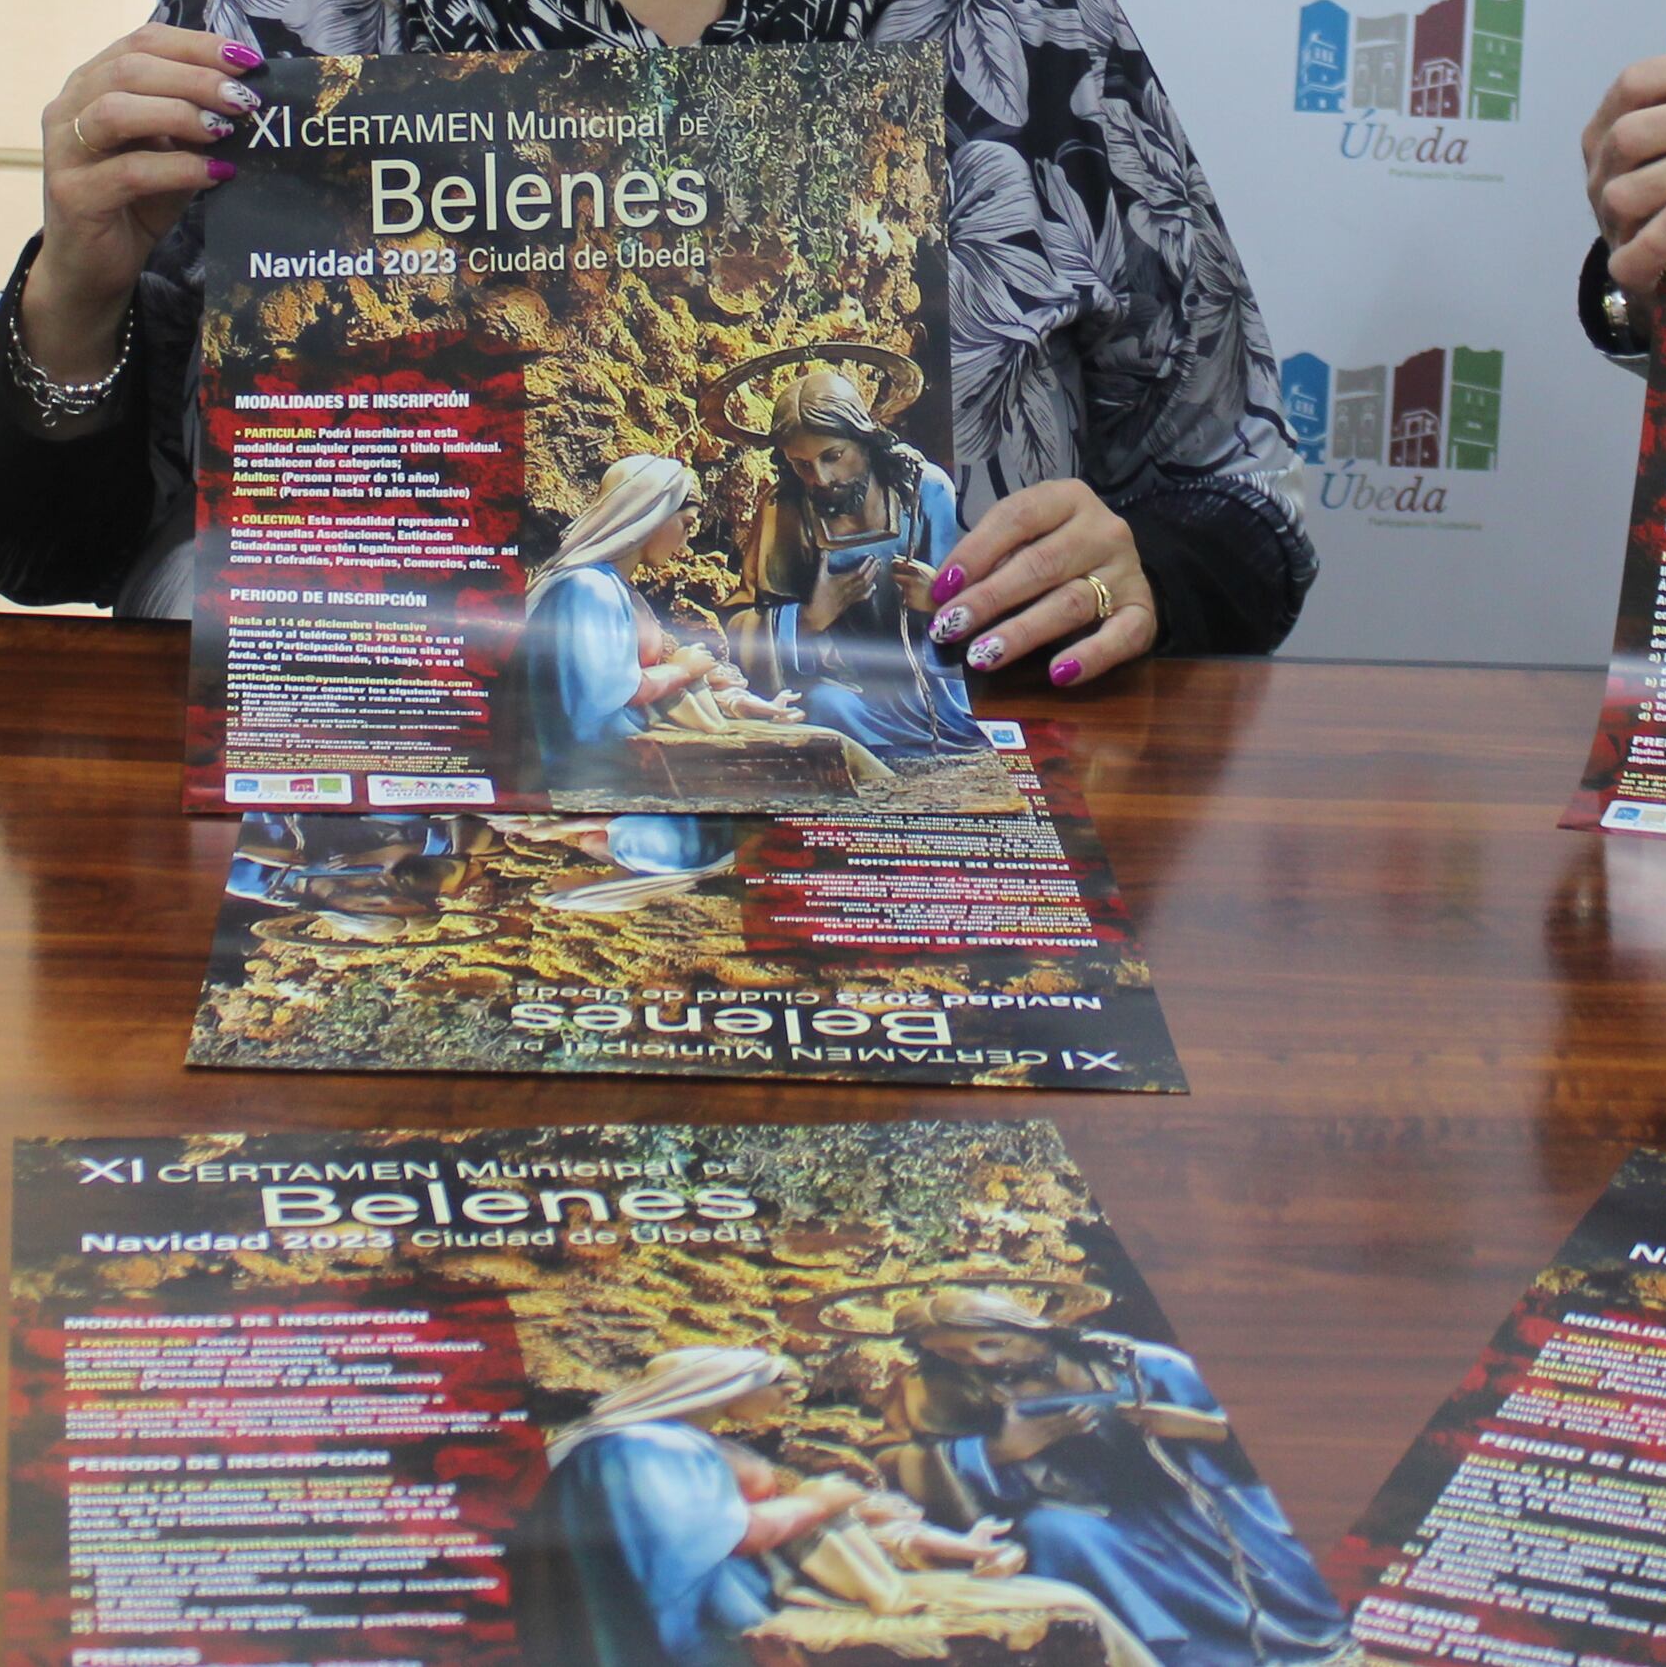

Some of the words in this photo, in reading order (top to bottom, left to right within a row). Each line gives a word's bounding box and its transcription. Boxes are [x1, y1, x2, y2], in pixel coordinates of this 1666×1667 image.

[248, 106, 290, 148] XI
[301, 112, 493, 146] CERTAMEN
[508, 107, 664, 144] Municipal
[679, 117, 708, 136] DE
[1341, 109, 1469, 164] Úbeda
[370, 152, 708, 235] Belenes
[250, 249, 374, 278] Navidad
[383, 246, 456, 274] 2023
[468, 245, 565, 272] Ciudad
[574, 244, 607, 270] de
[235, 395, 344, 409] MODALIDADES
[349, 394, 369, 408] DE
[373, 391, 470, 408] INSCRIPCIÓN
[245, 427, 315, 438] PARTICULAR:
[319, 427, 351, 438] Podrá
[354, 427, 413, 438] inscribirse
[417, 429, 431, 438] en
[434, 428, 458, 438] esta
[234, 443, 293, 453] modalidad
[296, 443, 349, 455] cualquier
[352, 445, 397, 455] persona
[401, 445, 407, 453] a
[411, 442, 440, 453] título
[443, 442, 501, 453] individual.
[234, 458, 247, 468] Se
[251, 458, 311, 468] establecen
[315, 458, 335, 468] dos
[233, 472, 279, 483] Adultos:
[282, 472, 331, 484] (Persona
[335, 474, 371, 485] mayor
[374, 472, 387, 483] de
[391, 473, 404, 483] 16
[408, 472, 440, 484] años)
[1321, 460, 1447, 513] Úbeda
[233, 486, 276, 497] Juvenil:
[280, 486, 330, 499] (Persona
[333, 487, 364, 497] hasta
[368, 487, 381, 497] 16
[385, 487, 412, 498] años
[415, 487, 470, 499] inclusive)
[230, 589, 298, 603] PERIODO
[303, 591, 323, 604] DE
[327, 591, 427, 607] INSCRIPCIÓN
[642, 988, 684, 1004] de
[696, 988, 820, 1006] Ciudad
[835, 991, 931, 1009] 2023
[942, 992, 1102, 1011] Navidad
[509, 1002, 952, 1046] Belenes
[565, 1041, 773, 1061] Municipal
[791, 1045, 1049, 1065] CERTAMEN
[1062, 1050, 1123, 1072] XI
[79, 1158, 143, 1185] XI
[157, 1161, 439, 1182] CERTAMEN
[457, 1158, 680, 1181] Municipal
[261, 1182, 758, 1228] Belenes
[81, 1231, 268, 1253] Navidad
[282, 1231, 392, 1250] 2023
[411, 1227, 553, 1248] Ciudad
[568, 1228, 617, 1248] de
[64, 1316, 234, 1330] MODALIDADES
[240, 1315, 271, 1328] DE
[277, 1311, 430, 1327] INSCRIPCIÓN
[1478, 1432, 1592, 1465] PERIODO
[1594, 1454, 1630, 1470] DE
[69, 1456, 179, 1472] PERIODO
[186, 1455, 219, 1470] DE
[226, 1451, 391, 1469] INSCRIPCIÓN
